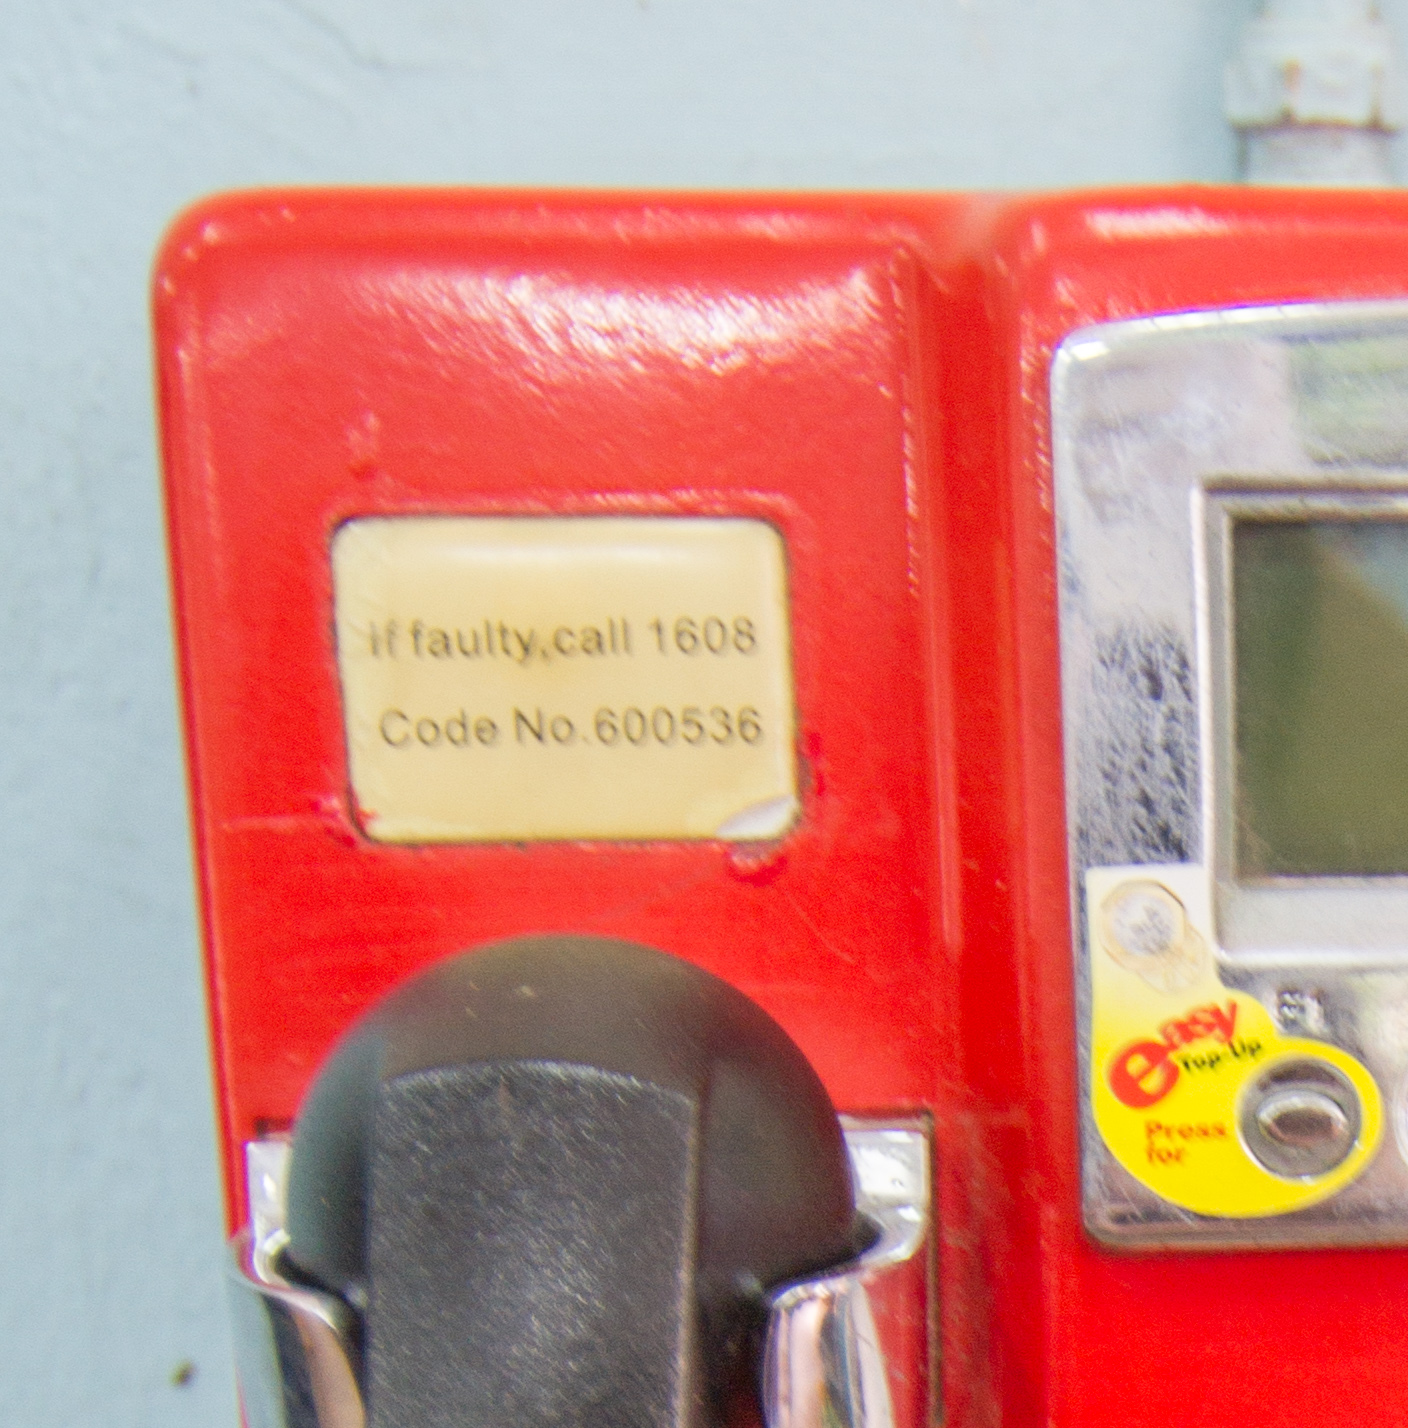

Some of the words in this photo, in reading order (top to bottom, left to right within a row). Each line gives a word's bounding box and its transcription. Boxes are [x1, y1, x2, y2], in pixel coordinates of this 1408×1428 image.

[649, 615, 758, 654] 1608
[379, 708, 498, 748] Code
[514, 706, 763, 747] No.600536
[1145, 1120, 1227, 1143] Press
[1147, 1144, 1186, 1166] for
